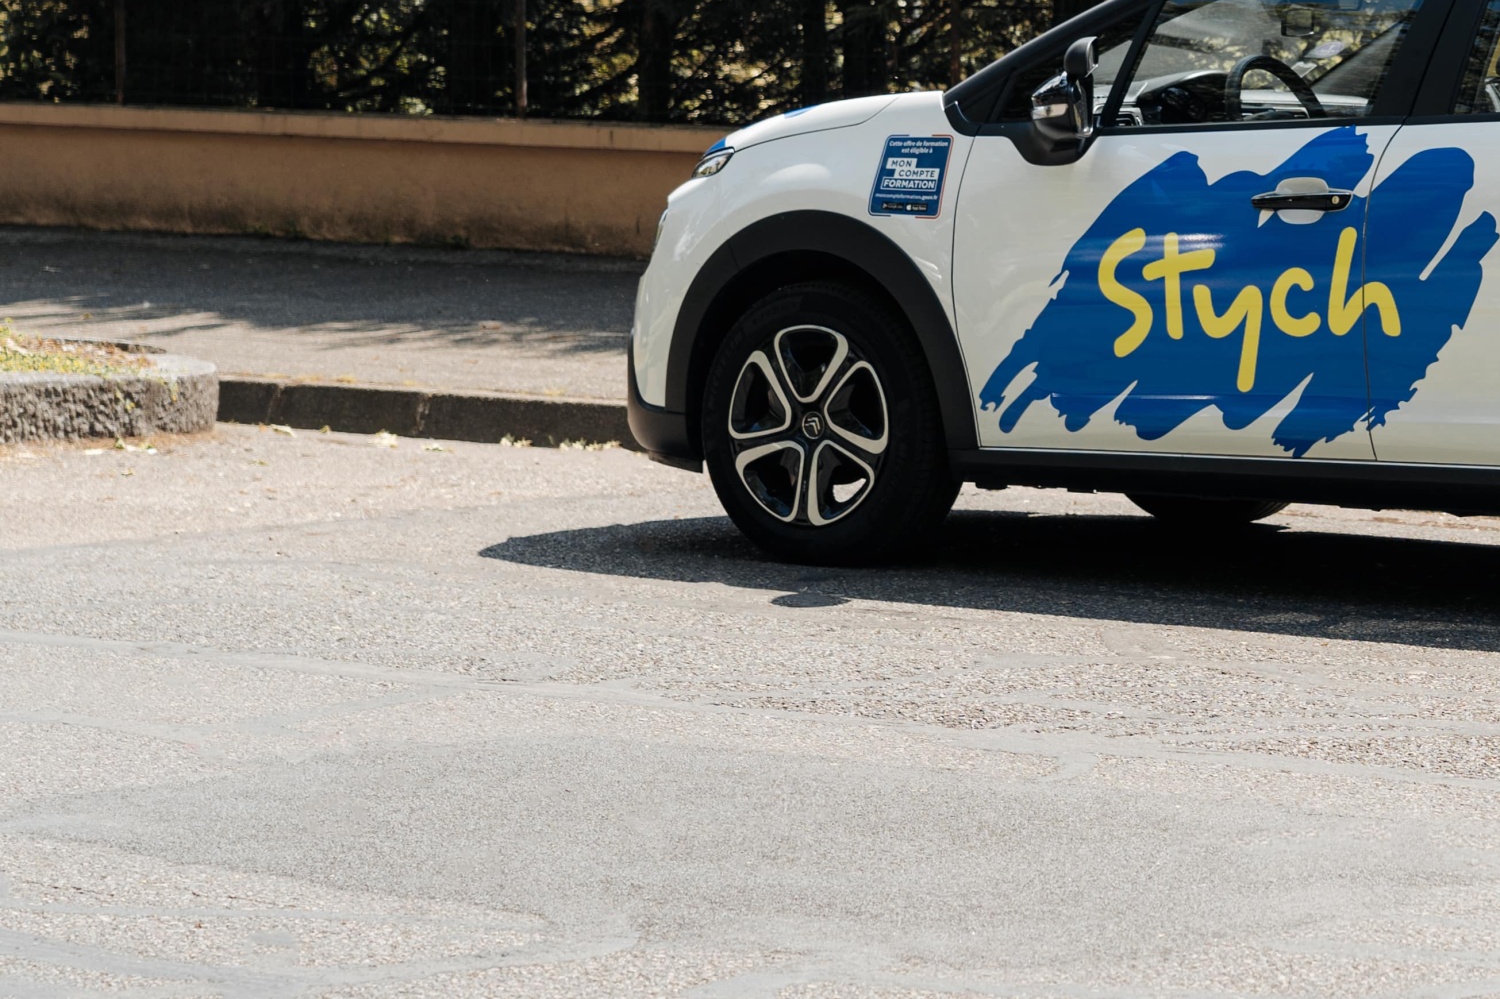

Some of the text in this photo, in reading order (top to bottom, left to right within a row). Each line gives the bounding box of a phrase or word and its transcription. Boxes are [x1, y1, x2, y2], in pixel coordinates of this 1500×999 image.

[890, 159, 912, 167] MON
[898, 169, 936, 178] COMPTE
[883, 179, 935, 189] FORMATION
[1098, 226, 1401, 393] Stych
